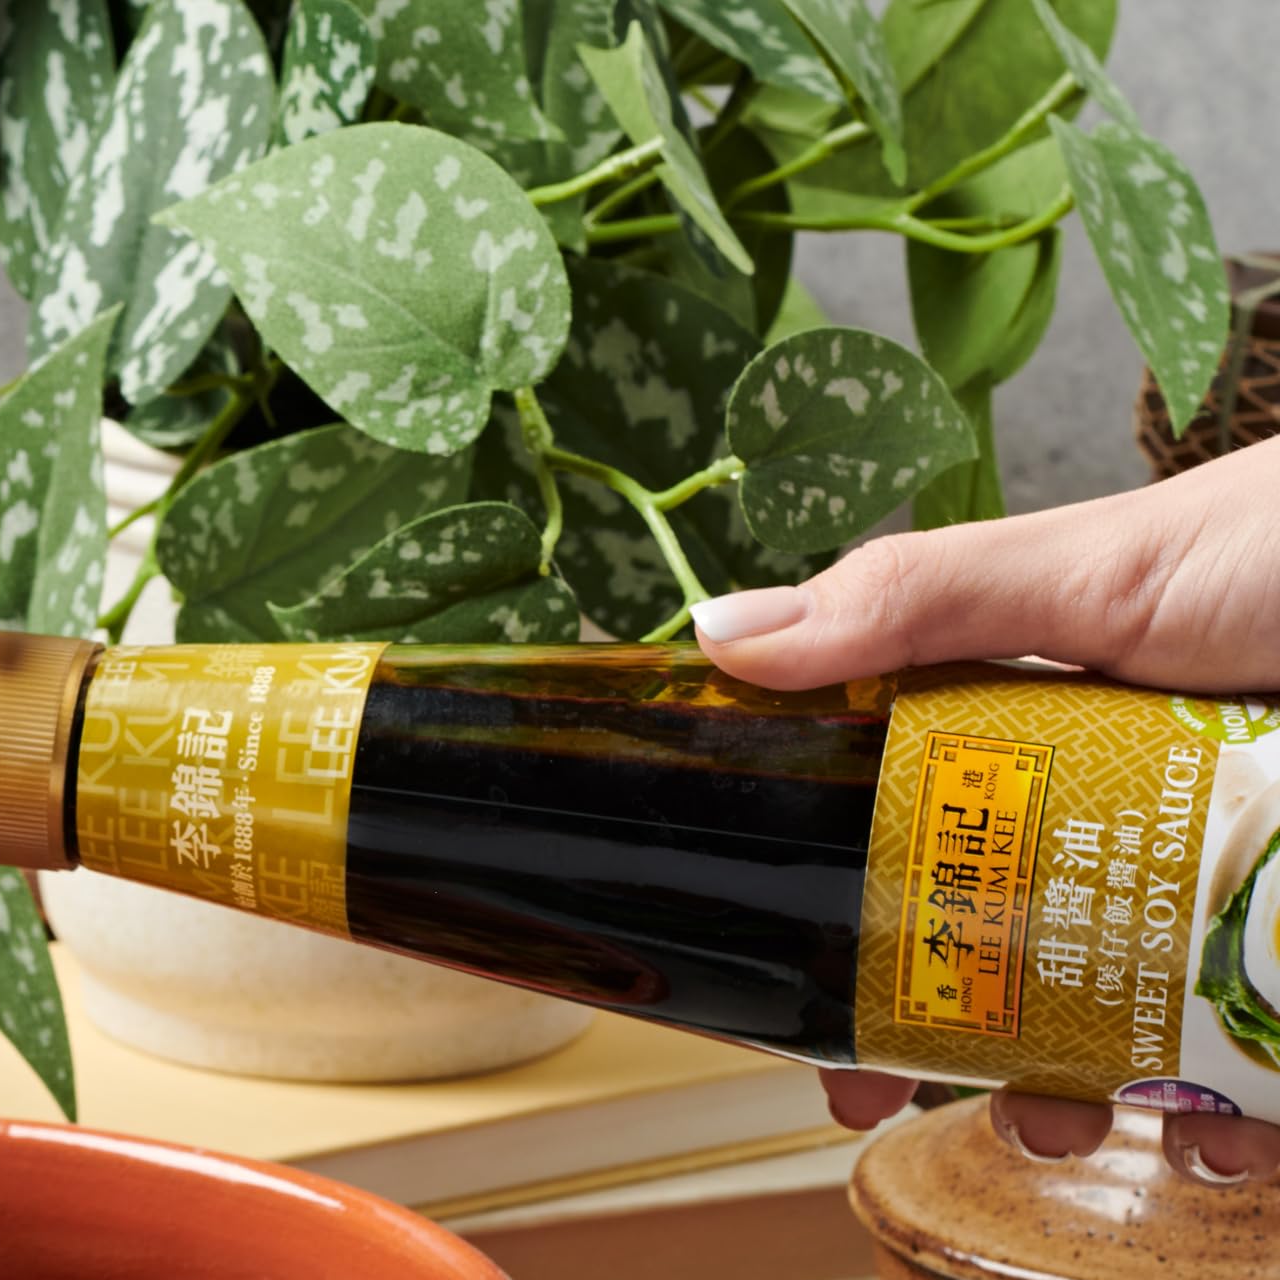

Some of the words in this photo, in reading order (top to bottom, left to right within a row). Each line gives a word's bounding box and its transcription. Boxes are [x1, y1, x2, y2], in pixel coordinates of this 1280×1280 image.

[247, 665, 276, 704] 1888
[238, 712, 264, 772] Since
[307, 705, 359, 778] LEE
[170, 706, 233, 870] 李錦記
[962, 769, 984, 789] 港
[984, 762, 1000, 800] KONG
[1152, 745, 1202, 863] SAUCE
[991, 809, 1018, 857] KEE
[923, 803, 990, 971] 李錦記
[983, 863, 1011, 927] KUM
[1036, 818, 1106, 989] 甜醬油
[1140, 872, 1181, 953] SOY
[978, 935, 1003, 976] LEE
[937, 983, 958, 1001] 香
[960, 976, 974, 1014] HONG
[1131, 962, 1170, 1071] SWEET
